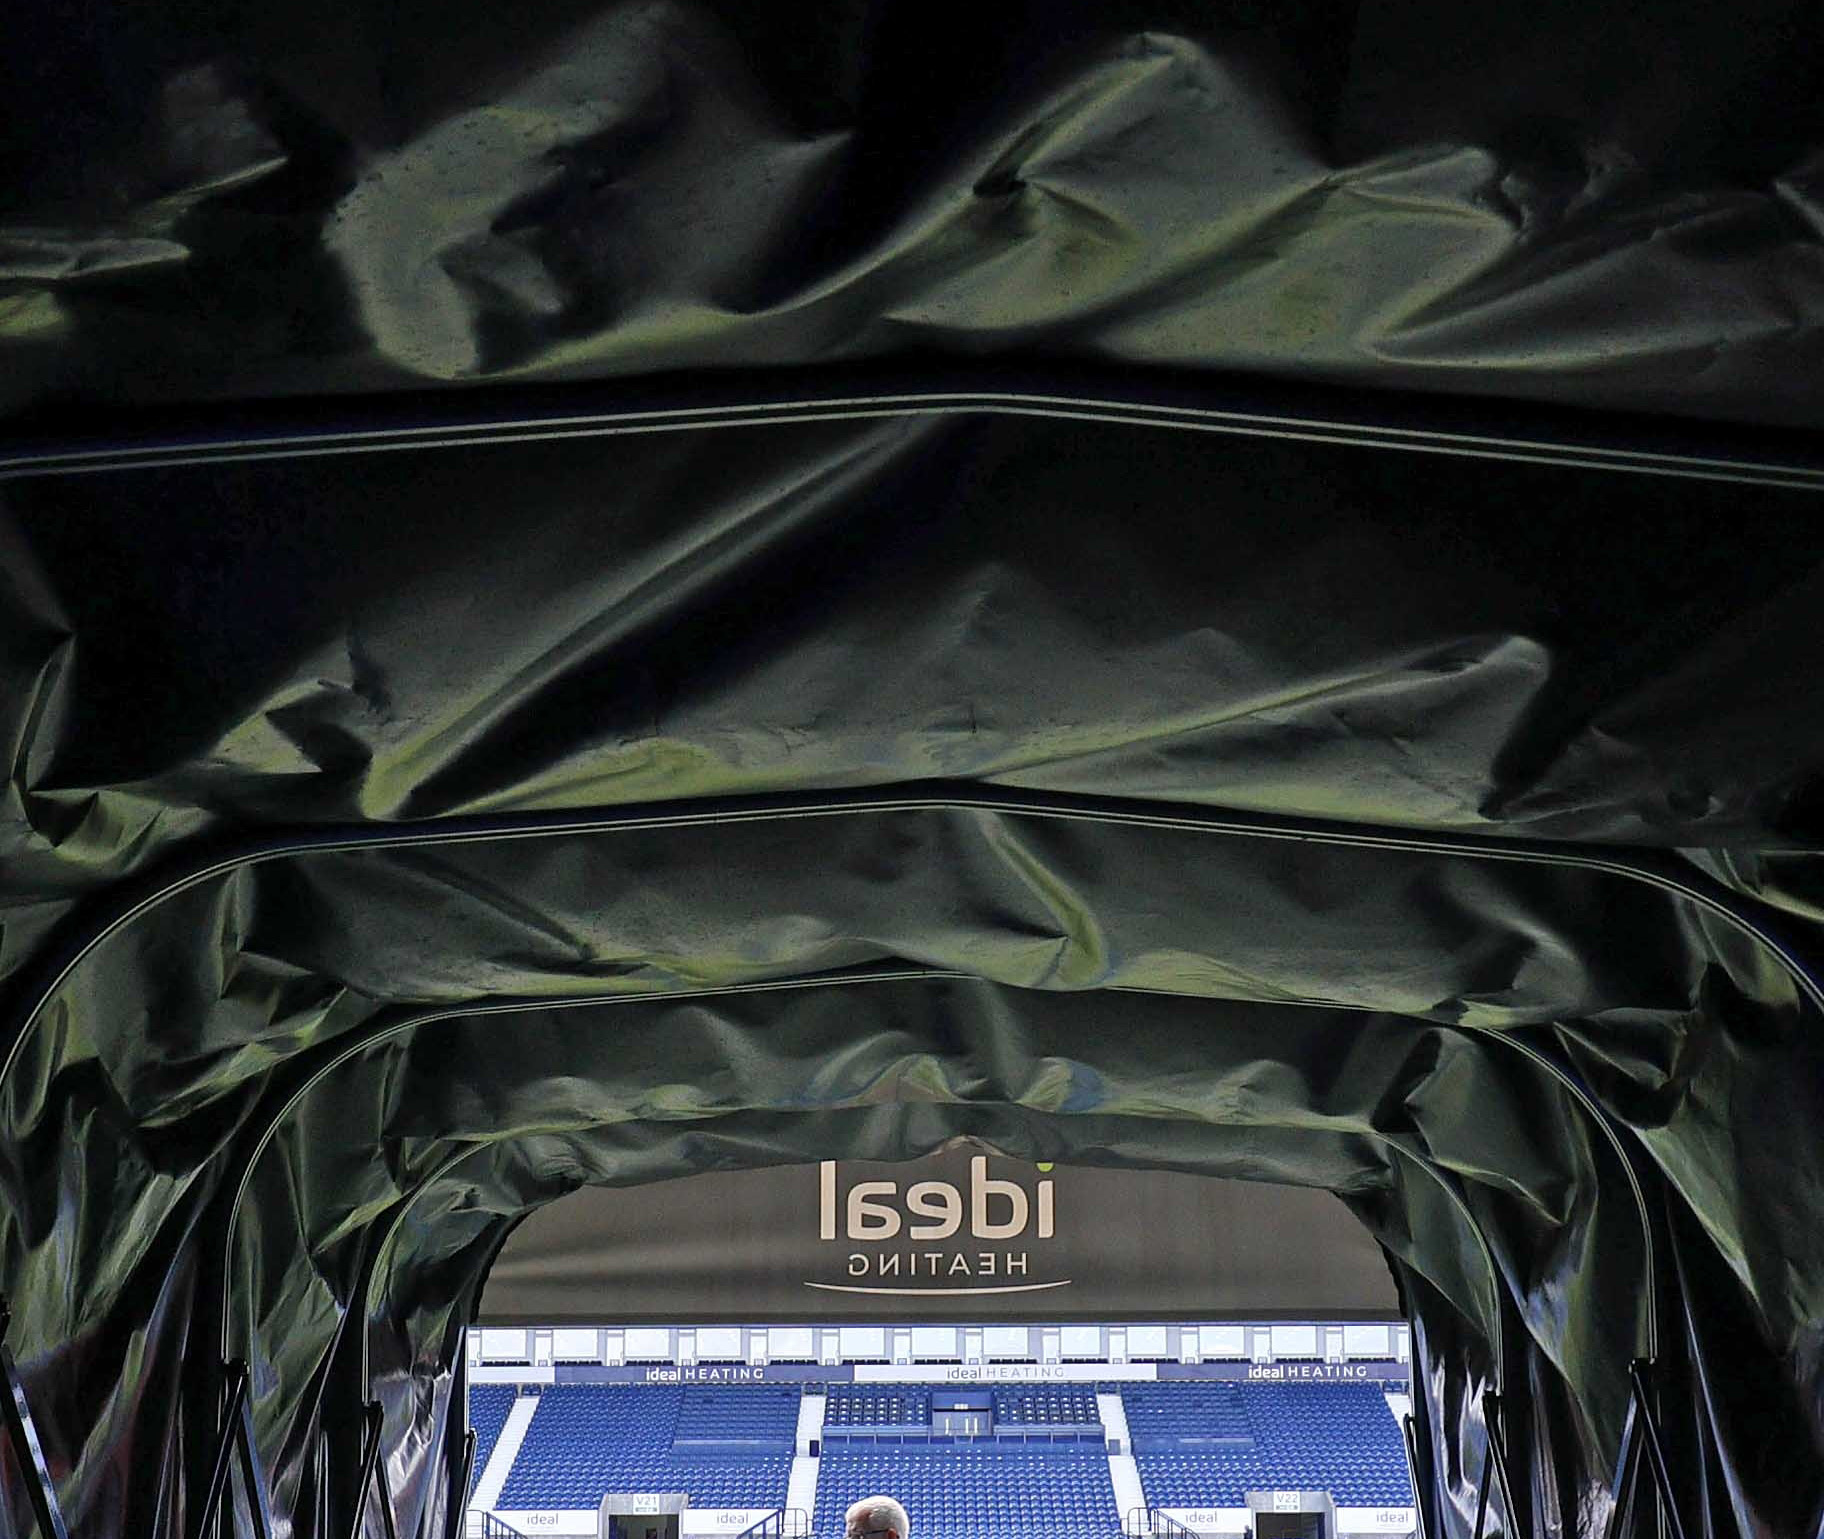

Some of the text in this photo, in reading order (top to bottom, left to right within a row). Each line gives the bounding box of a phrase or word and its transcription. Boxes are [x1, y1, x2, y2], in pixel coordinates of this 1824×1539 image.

[646, 1366, 764, 1381] ideal HEATING
[946, 1366, 1065, 1380] ideal HEATING
[1248, 1365, 1367, 1379] ideal HEATING
[636, 1496, 657, 1506] V21
[1276, 1494, 1298, 1504] V22
[527, 1512, 559, 1525] ideal
[716, 1512, 749, 1524] ideal
[1185, 1510, 1217, 1523] ideal
[1376, 1510, 1409, 1523] ideal
